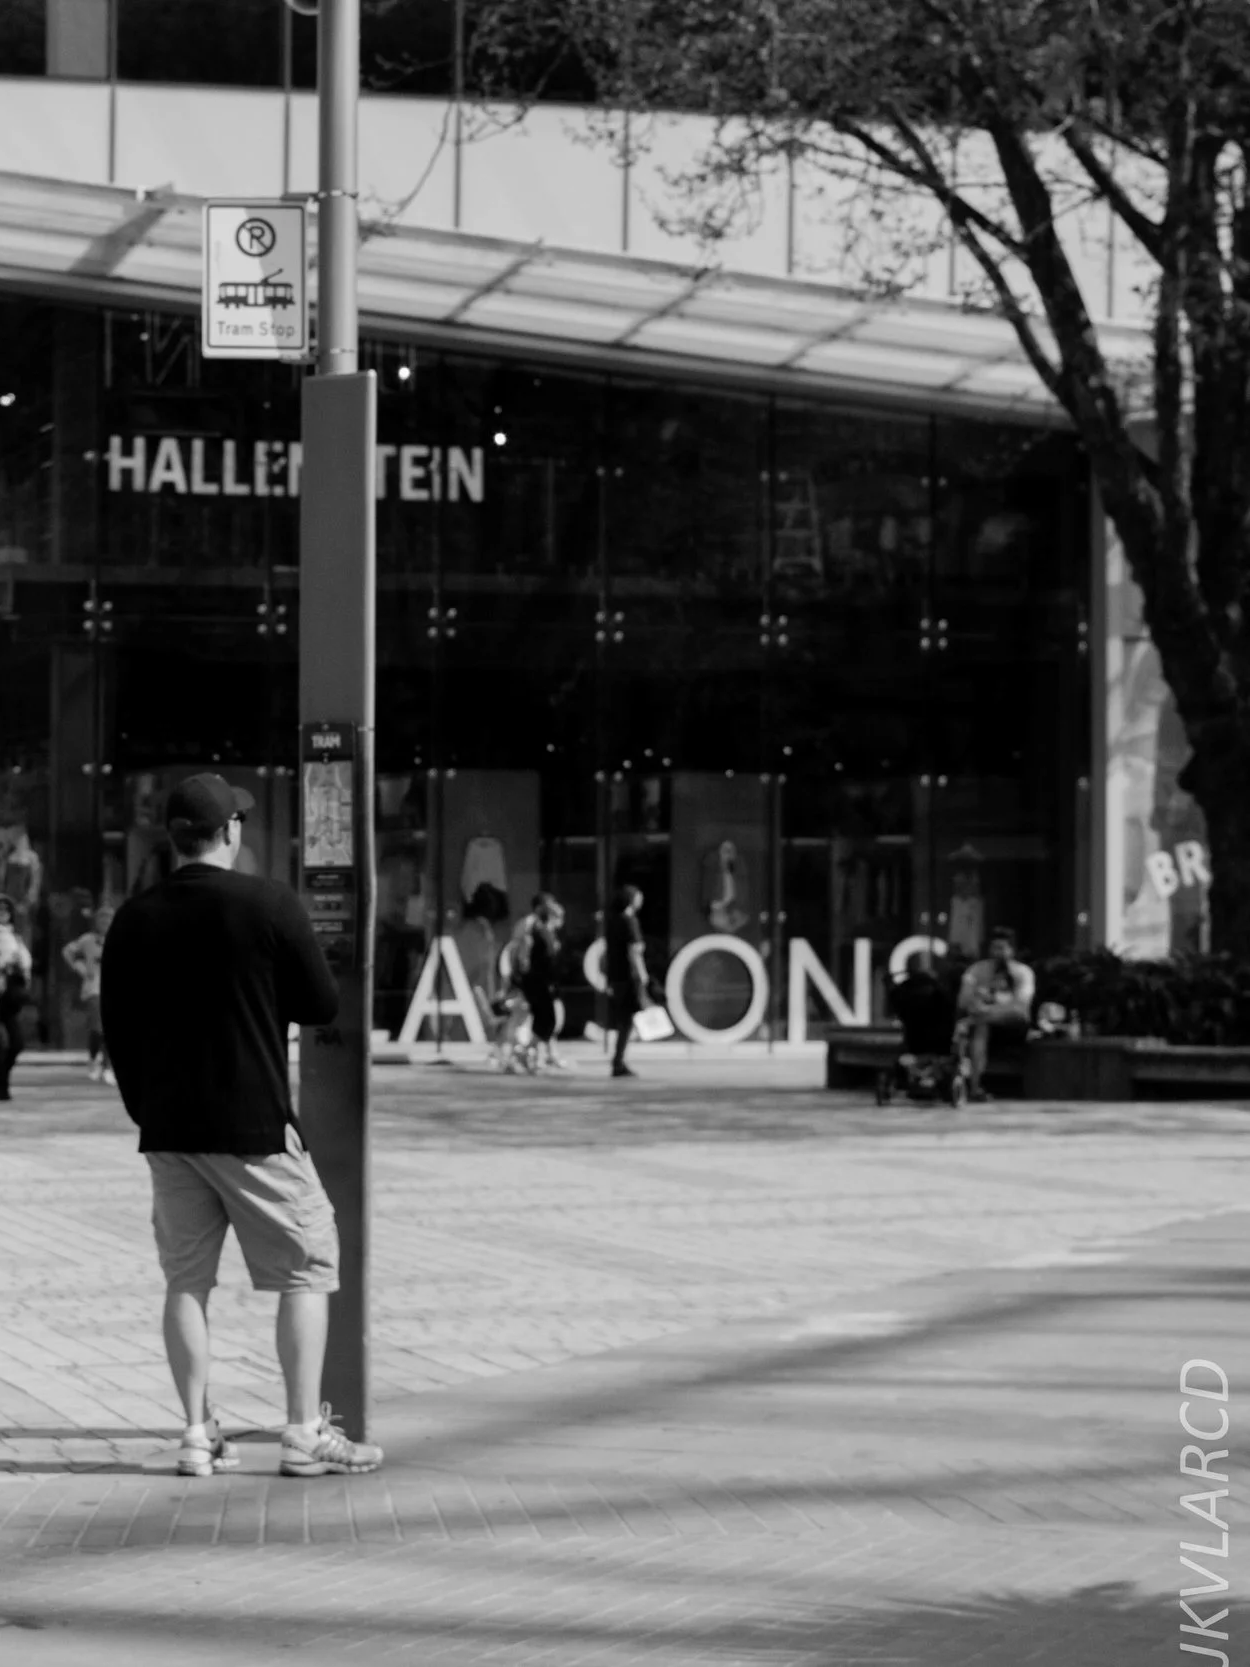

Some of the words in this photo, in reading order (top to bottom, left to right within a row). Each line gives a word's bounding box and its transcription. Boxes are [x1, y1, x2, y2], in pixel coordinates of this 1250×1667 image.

[217, 320, 253, 336] Tram
[259, 321, 295, 338] Stop
[108, 435, 484, 502] HALLETEIN
